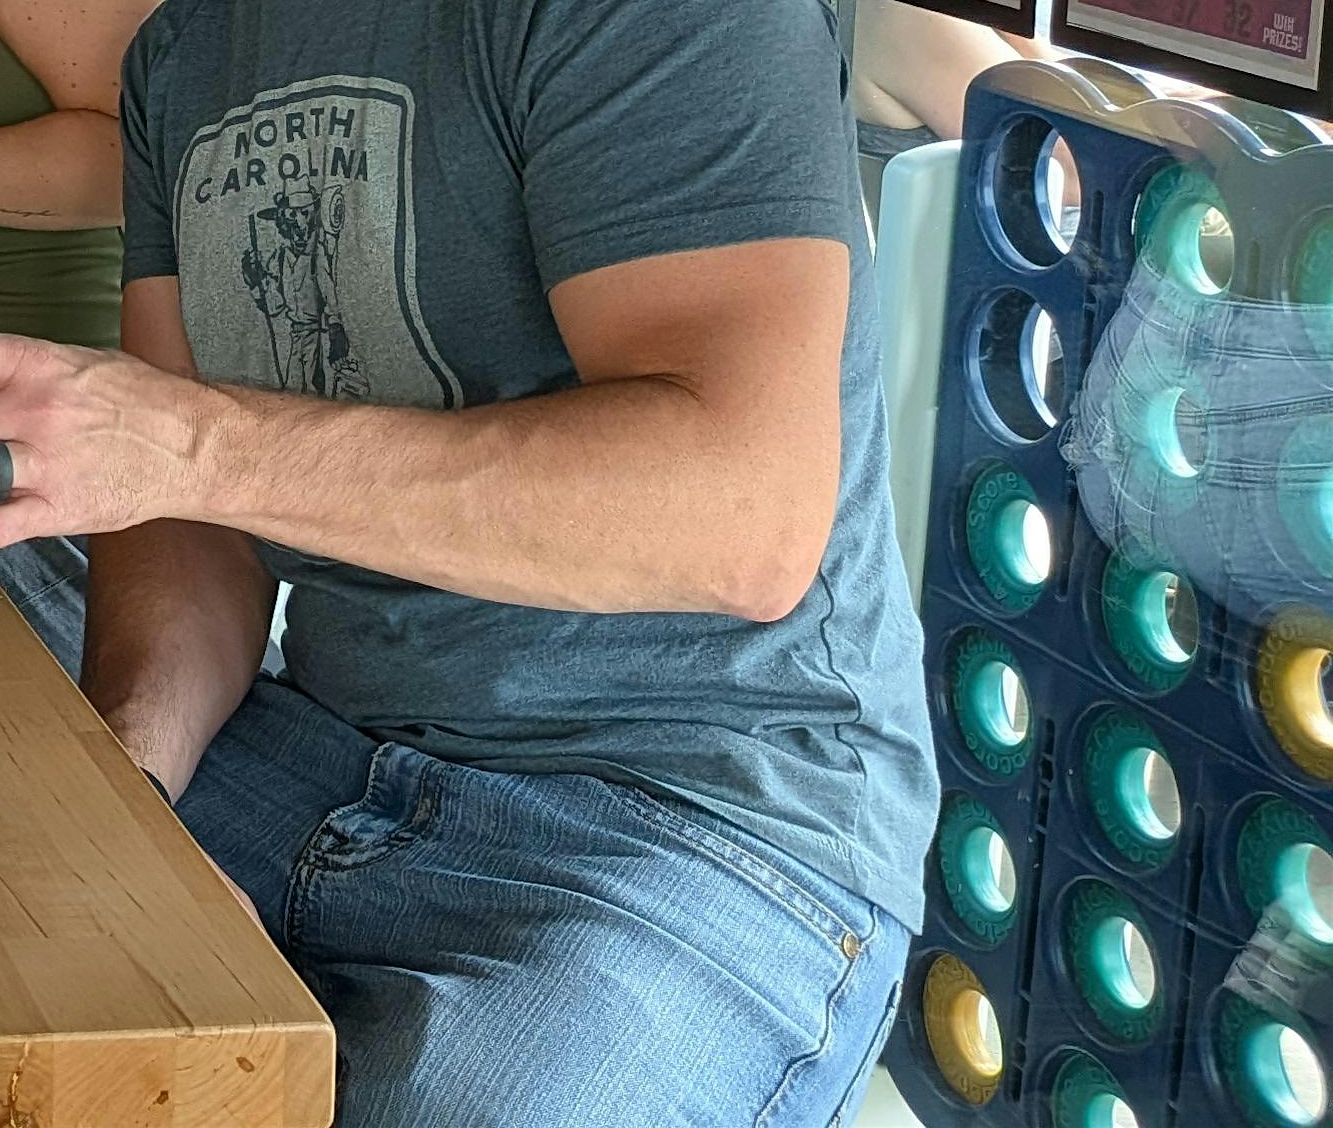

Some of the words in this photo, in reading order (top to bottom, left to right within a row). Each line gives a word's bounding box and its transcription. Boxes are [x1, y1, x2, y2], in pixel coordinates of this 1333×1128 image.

[1263, 28, 1302, 53] PRIZES!
[234, 106, 355, 159] NORTH
[194, 145, 369, 205] CAROLINA
